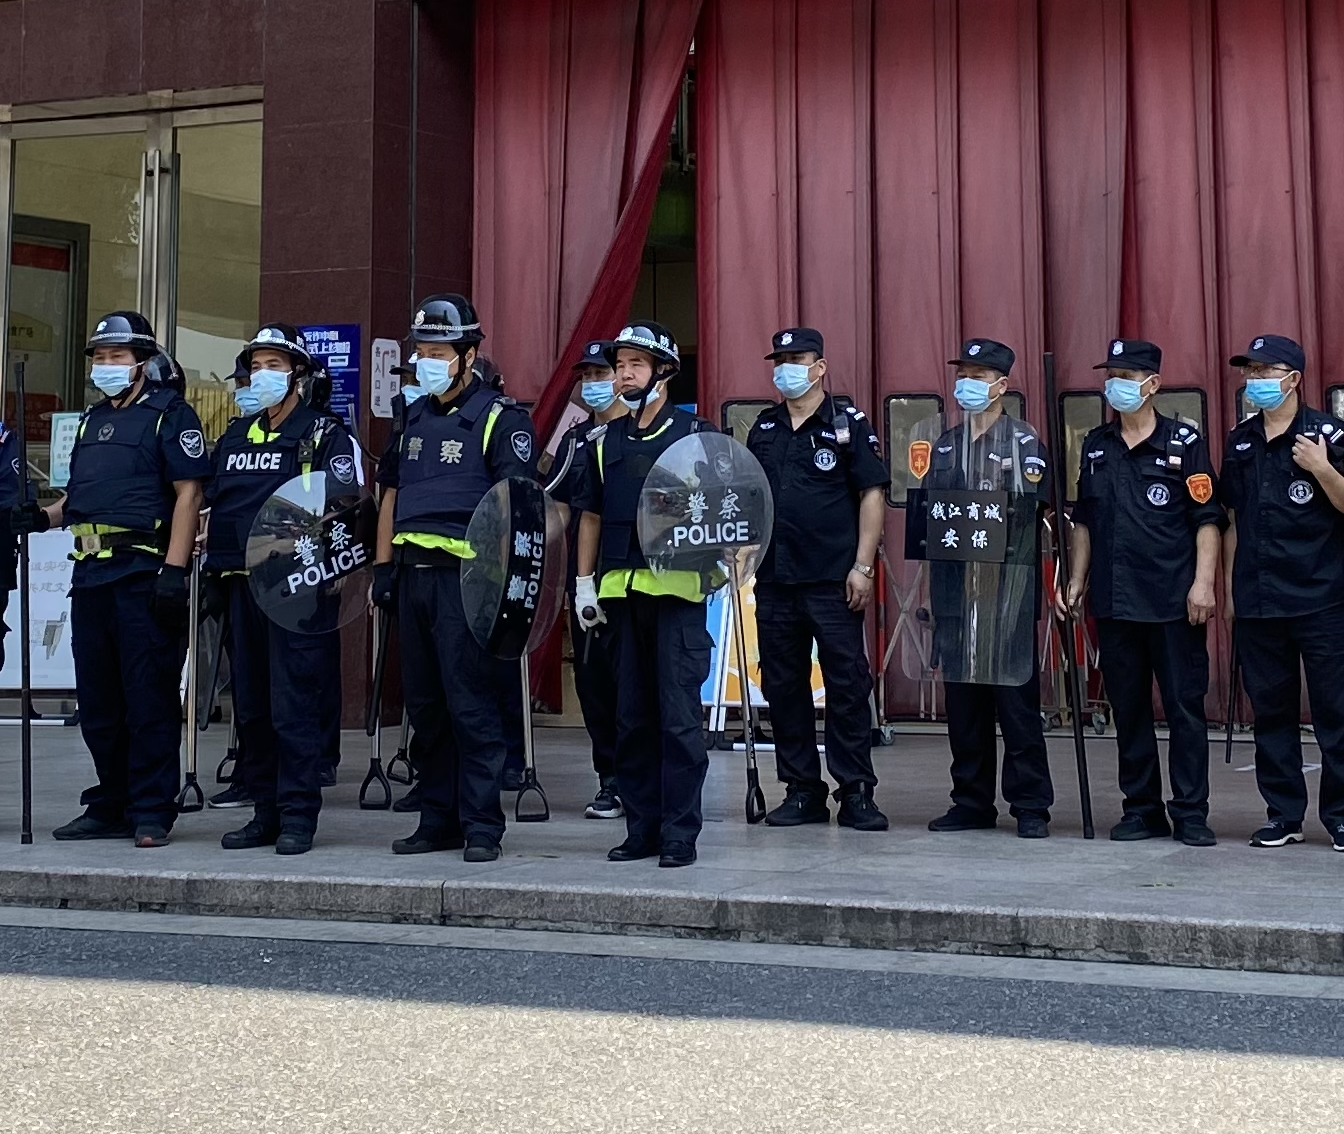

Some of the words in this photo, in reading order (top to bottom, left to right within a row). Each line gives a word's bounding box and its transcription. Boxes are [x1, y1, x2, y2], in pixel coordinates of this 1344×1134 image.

[226, 452, 283, 471] POLICE
[408, 436, 464, 465] 警察
[685, 489, 742, 524] 警察
[931, 501, 1003, 523] 钱江商城
[293, 520, 353, 567] 警察
[673, 521, 750, 548] POLICE
[940, 528, 988, 549] 安保
[287, 542, 367, 595] POLICE
[524, 530, 545, 610] POLICE
